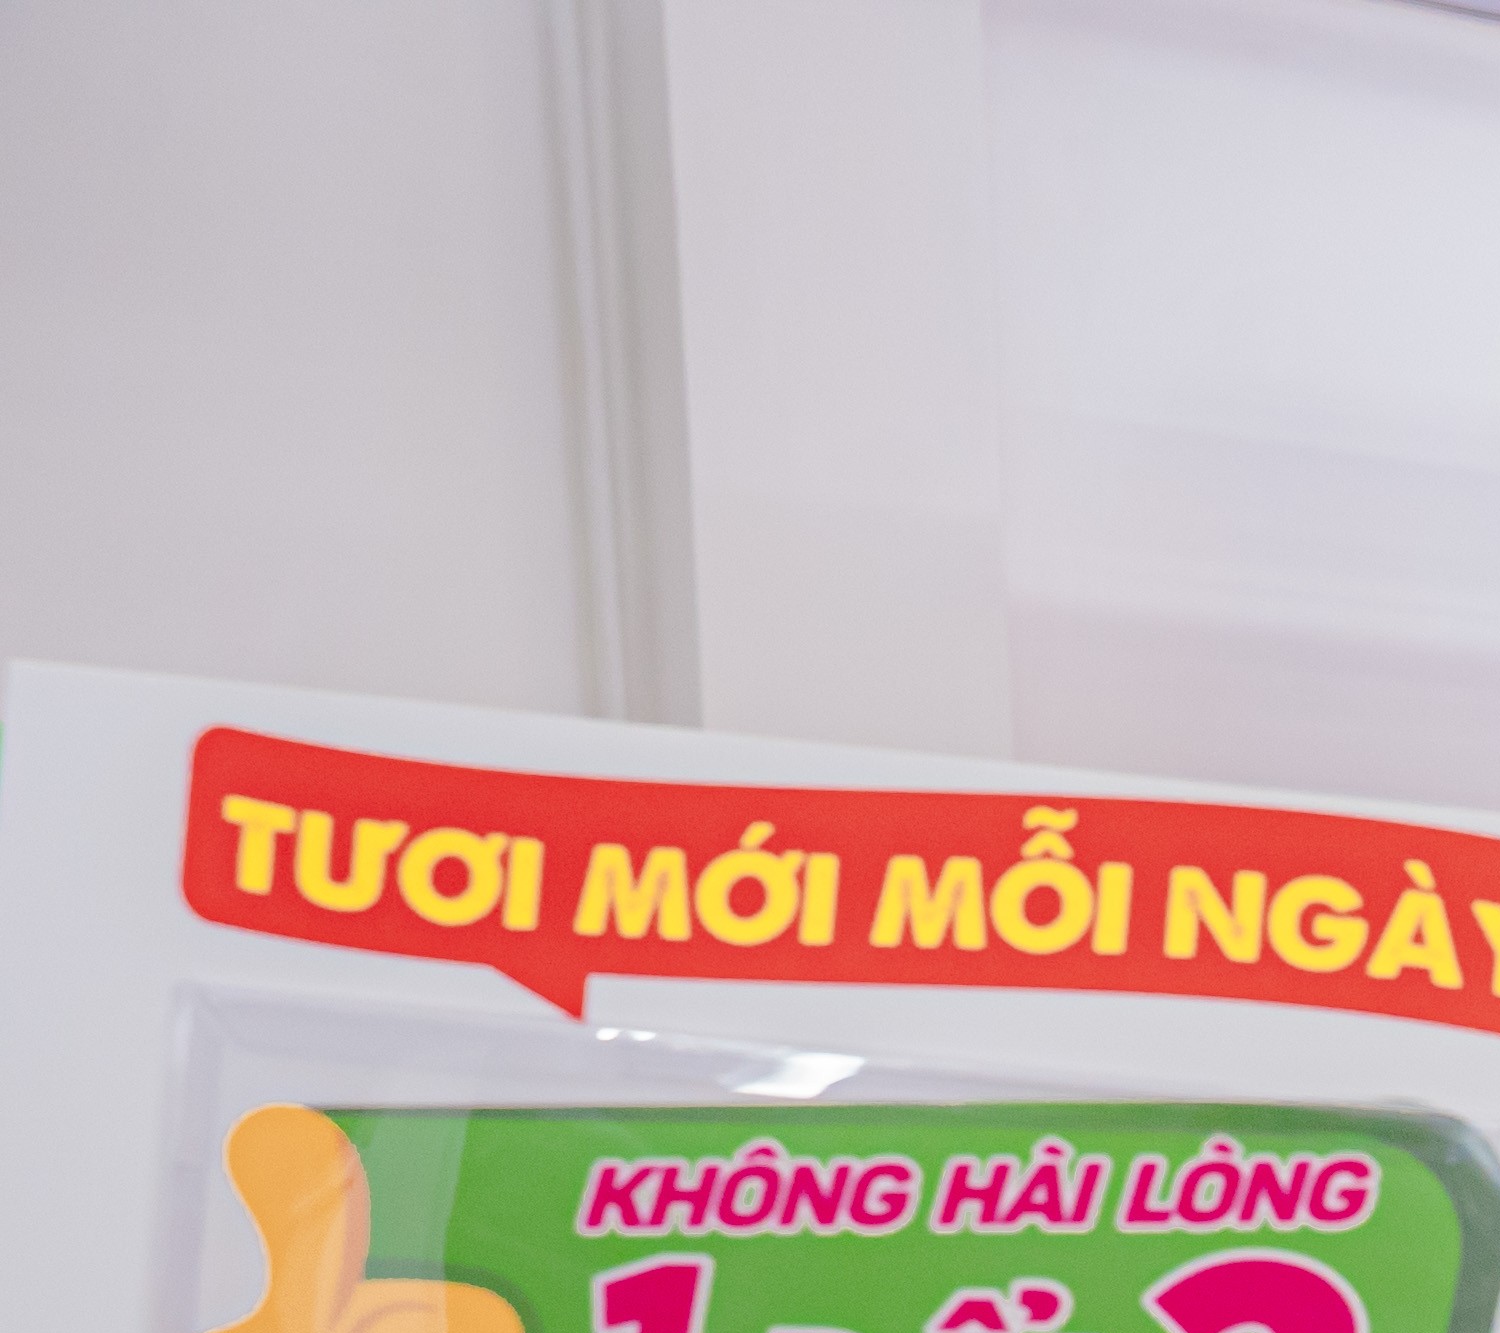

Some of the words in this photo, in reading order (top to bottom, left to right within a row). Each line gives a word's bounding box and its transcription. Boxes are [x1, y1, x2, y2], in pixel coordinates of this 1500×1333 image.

[222, 795, 544, 931] TƯƠI
[573, 821, 840, 946] MỚI
[869, 805, 1133, 955] MỖI
[577, 1134, 920, 1236] KHÔNG
[931, 1135, 1112, 1232] HÀI
[1116, 1135, 1381, 1232] LÒNG
